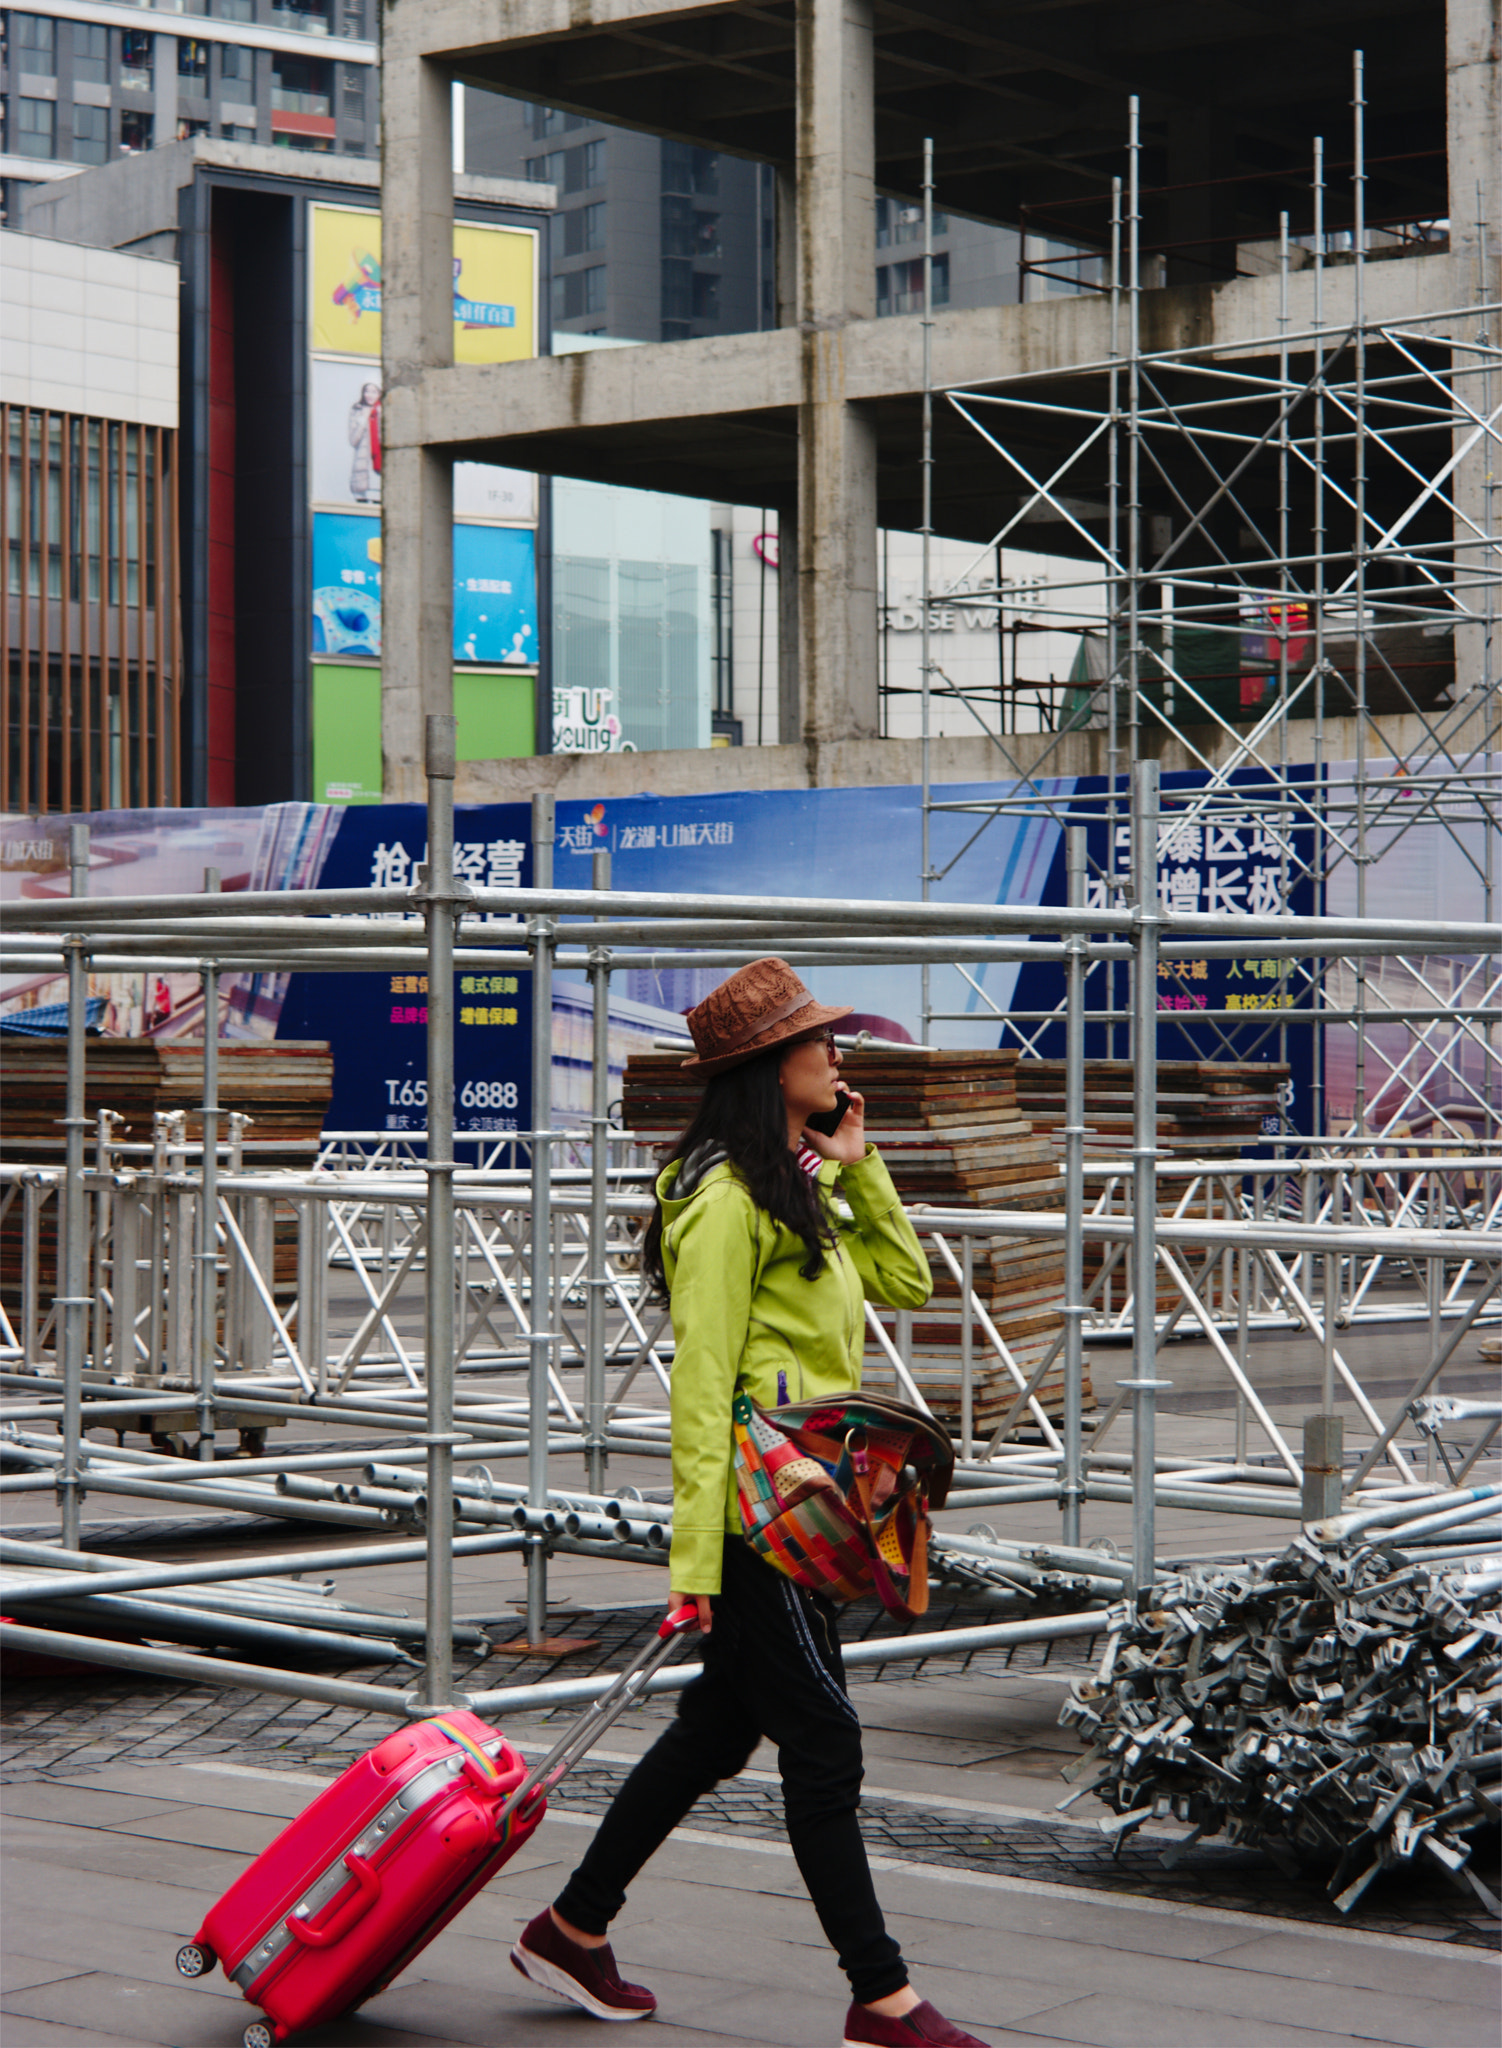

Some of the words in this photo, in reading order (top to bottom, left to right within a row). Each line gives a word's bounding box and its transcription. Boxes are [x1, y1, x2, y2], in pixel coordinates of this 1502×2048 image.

[878, 608, 956, 631] ADISE
[559, 825, 592, 848] 天街
[370, 839, 526, 887] 抢经营
[1156, 959, 1208, 979] 年大城
[390, 976, 429, 994] 运营保
[460, 976, 518, 994] 模式保障
[390, 1006, 428, 1024] 品牌保
[459, 1007, 518, 1025] 增值保障
[461, 1081, 519, 1108] 6888
